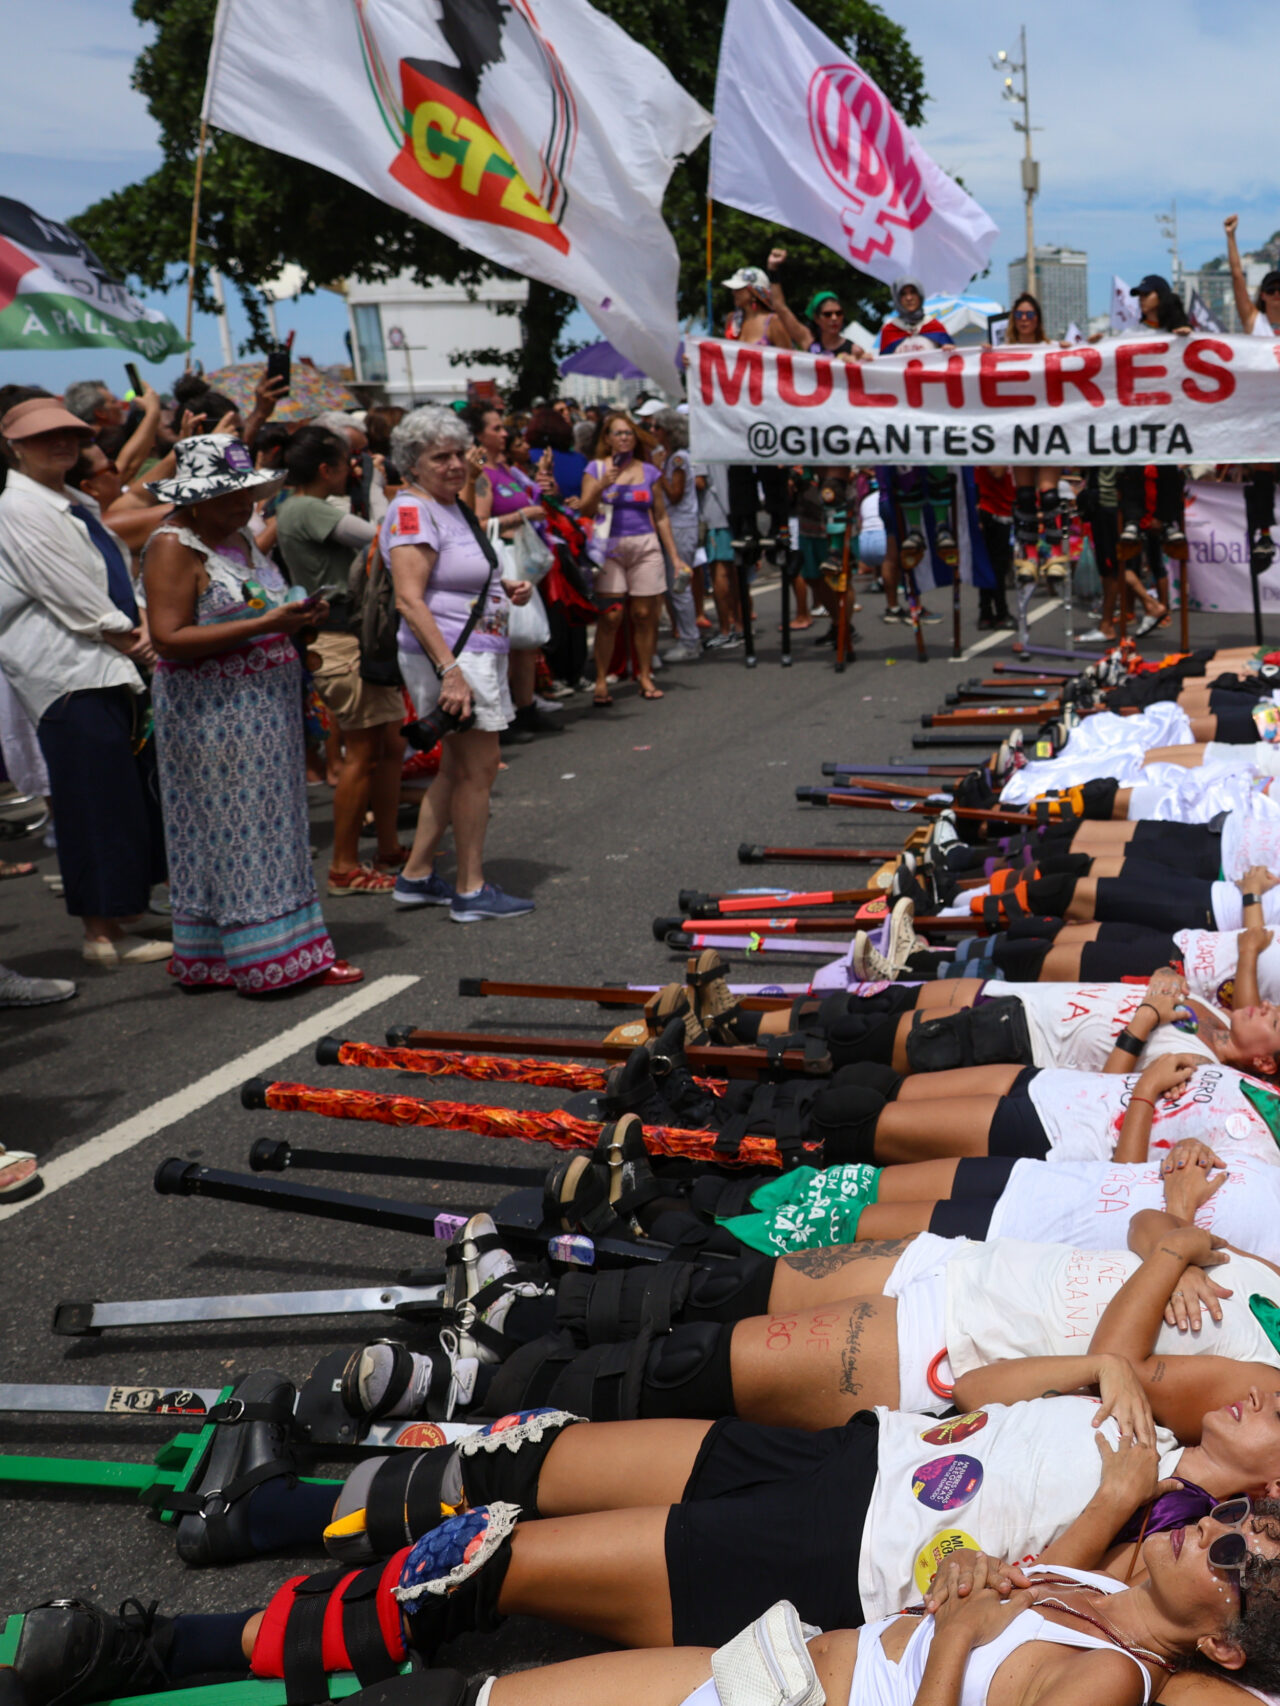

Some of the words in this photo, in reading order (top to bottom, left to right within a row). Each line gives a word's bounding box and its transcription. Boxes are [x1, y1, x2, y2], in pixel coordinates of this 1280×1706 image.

[698, 338, 1236, 409] MULHERES
[747, 421, 996, 459] @GIGANTES
[1013, 423, 1071, 457] NA
[1088, 422, 1193, 457] LUTA
[1193, 1070, 1223, 1104] QUERO
